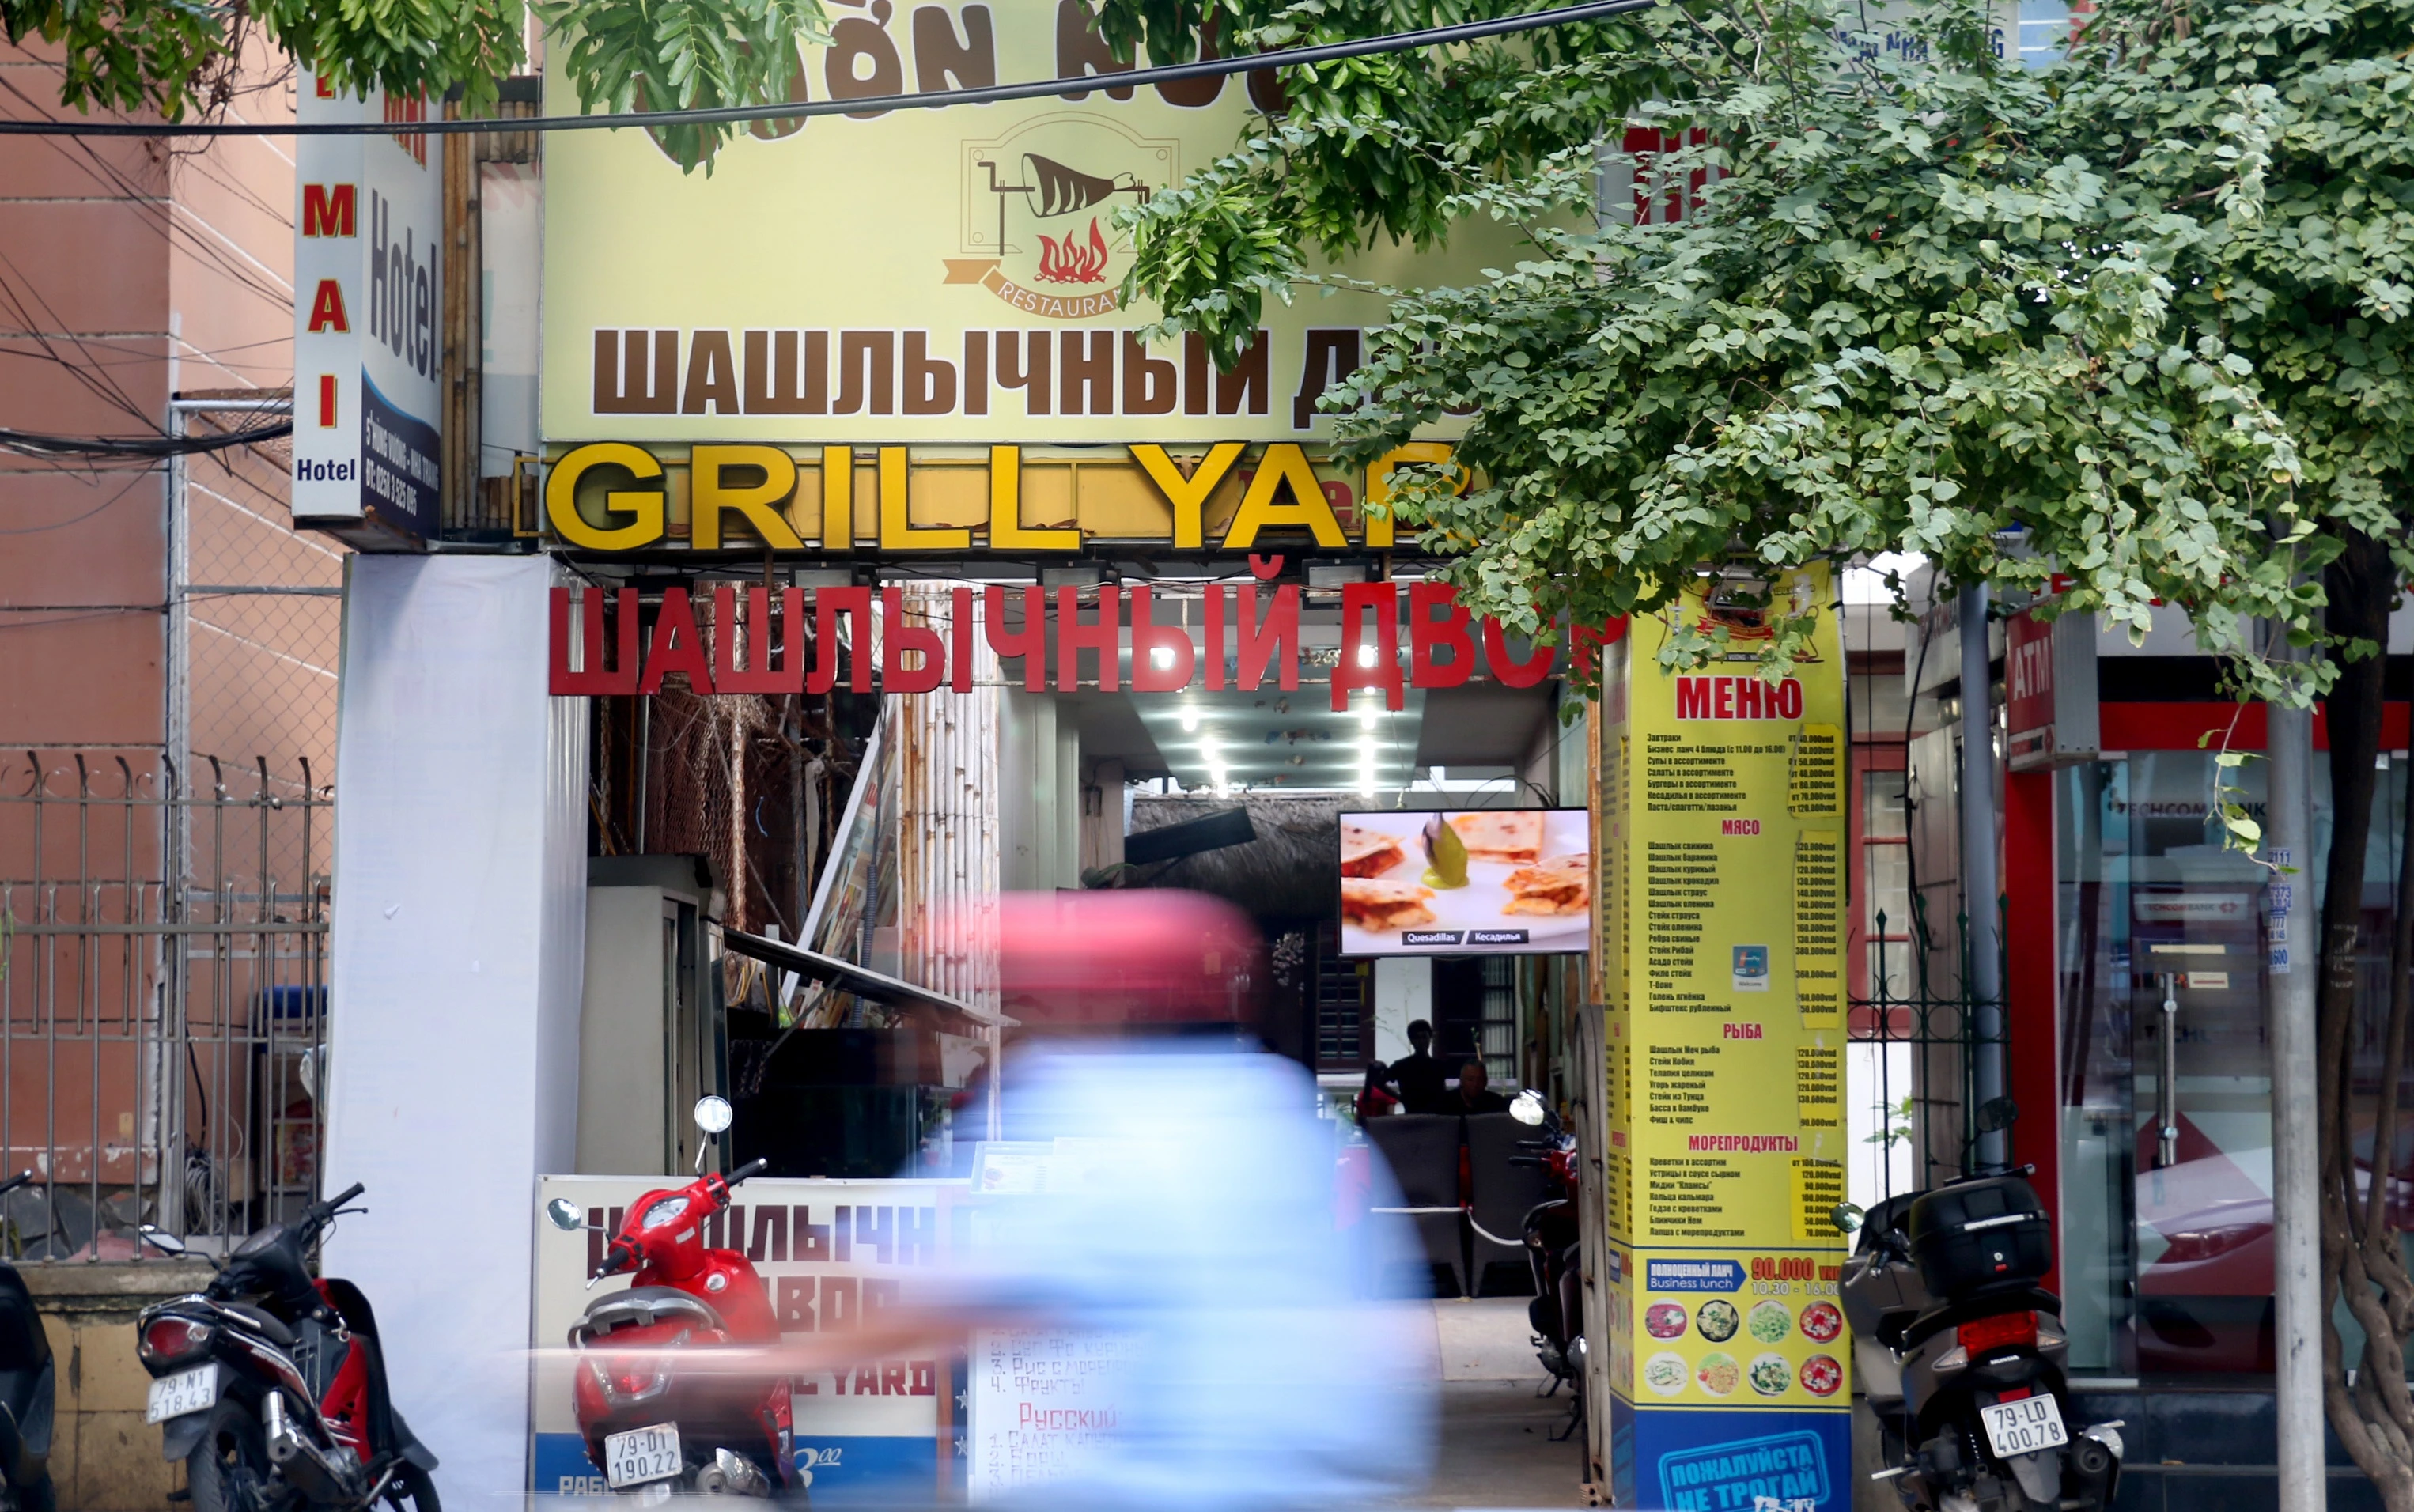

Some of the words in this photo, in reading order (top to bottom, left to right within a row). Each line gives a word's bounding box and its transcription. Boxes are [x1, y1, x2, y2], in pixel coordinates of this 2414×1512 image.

[371, 188, 437, 383] Hotel
[297, 459, 355, 481] Hotel
[546, 442, 1080, 550] GRILL
[1129, 443, 1479, 549] YAR
[551, 554, 1299, 694] ШАШЛЫЧНЫЙ
[2014, 637, 2049, 701] ATM
[1676, 677, 1803, 720] МЕНЮ
[1648, 780, 1678, 788] Бургеры
[1722, 820, 1760, 835] МЯСО
[1408, 932, 1455, 943] Quesadillas
[1474, 932, 1520, 943] Кесадилья
[1671, 969, 1692, 977] стейк
[1723, 1024, 1762, 1038] РЫБА
[1701, 1045, 1720, 1054] рыба
[1650, 1080, 1669, 1089] Угорь
[1683, 1092, 1704, 1101] Тунца
[1689, 1136, 1798, 1153] МОРЕПРОДУКТЫ
[1650, 1181, 1674, 1189] Мидии
[1650, 1193, 1676, 1201] Кольца
[1650, 1215, 1686, 1224] Блинчики
[1650, 1227, 1674, 1236] Лапша
[1651, 1262, 1710, 1279] ПОЛНОЦЕННЫЙ
[1712, 1265, 1733, 1277] ЛАНЧ
[1751, 1257, 1814, 1280] 90.000
[1651, 1278, 1697, 1288] Business
[1701, 1278, 1733, 1288] lunch
[1751, 1283, 1790, 1295] 10.30
[159, 1370, 204, 1399] 79-N1
[151, 1388, 210, 1419] 518.43
[1995, 1401, 2047, 1430] 79-LD
[617, 1432, 666, 1458] 79-D1
[1997, 1422, 2060, 1452] 400.78
[614, 1452, 676, 1482] 190.22
[1671, 1444, 1814, 1487] ПОЖАЛУЙСТА
[1675, 1487, 1712, 1512] НЕ
[1714, 1465, 1818, 1508] ТРОГАЙ
